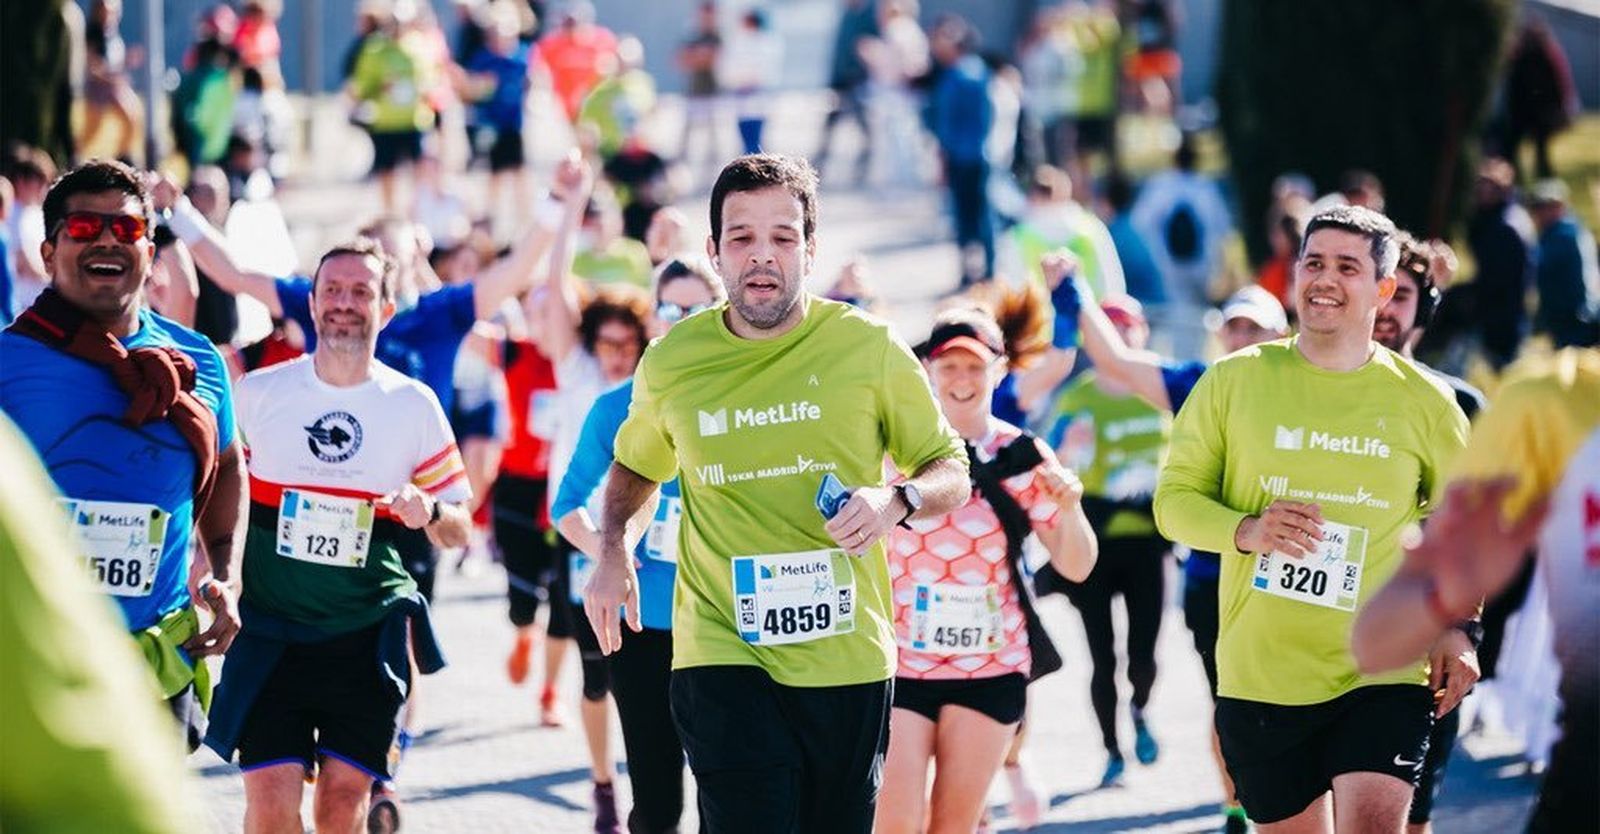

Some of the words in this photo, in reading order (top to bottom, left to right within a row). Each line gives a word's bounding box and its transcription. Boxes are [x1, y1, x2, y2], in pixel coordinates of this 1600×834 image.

[735, 401, 821, 429] MetLife
[1309, 431, 1391, 459] MetLife
[696, 463, 725, 486] VIII
[1259, 475, 1289, 497] VIII
[99, 514, 145, 527] MetLife
[307, 534, 340, 558] 123
[88, 556, 142, 587] 568
[781, 562, 828, 576] MetLife
[1280, 563, 1328, 596] 320
[763, 603, 831, 635] 4859
[934, 626, 982, 647] 4567
